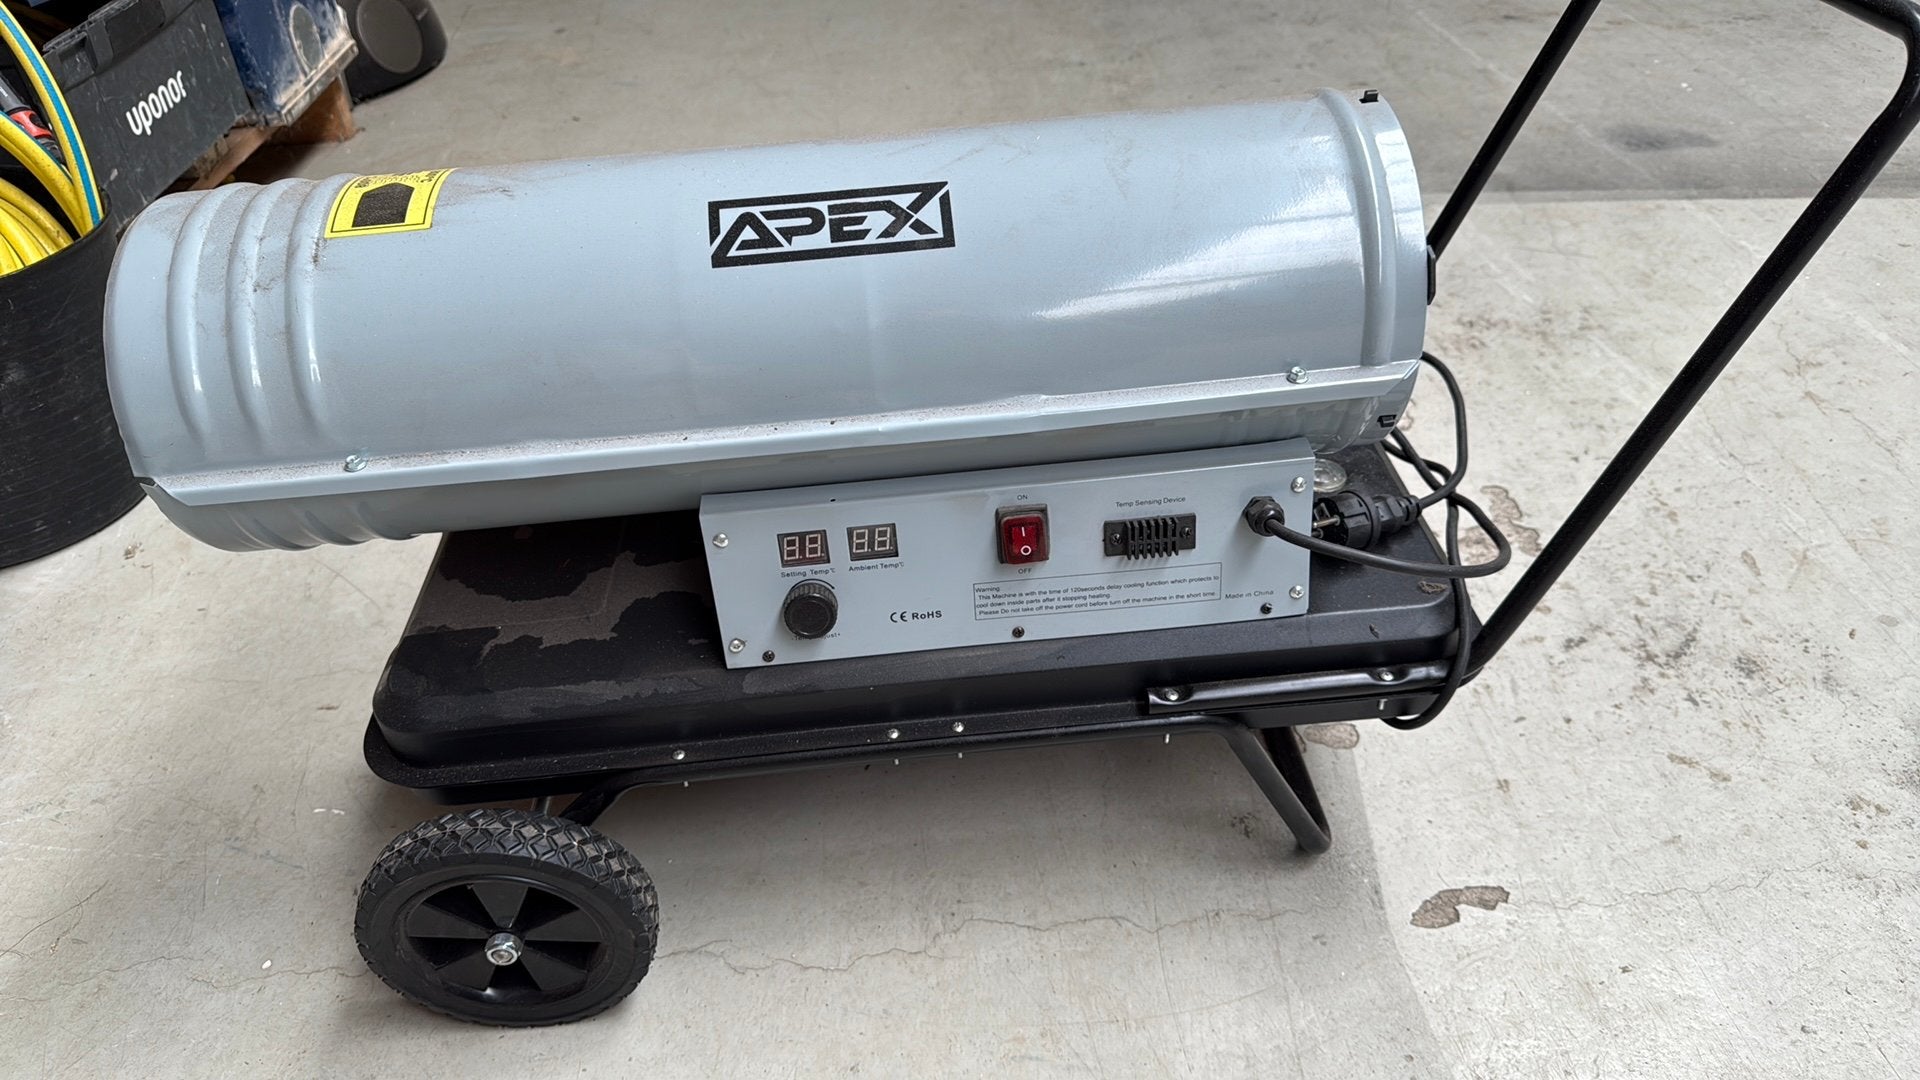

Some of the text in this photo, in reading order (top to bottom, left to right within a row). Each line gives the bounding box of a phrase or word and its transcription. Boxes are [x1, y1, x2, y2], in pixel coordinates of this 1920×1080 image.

[125, 70, 187, 136] uponor
[711, 184, 951, 267] APEX
[1135, 498, 1162, 506] Sensing
[1163, 496, 1186, 504] Device
[849, 563, 879, 572] Ambient
[780, 570, 807, 578] Setting
[992, 592, 1017, 600] Machine
[1106, 583, 1122, 591] delay
[1123, 581, 1145, 590] cooling
[1146, 579, 1170, 587] function
[1170, 577, 1187, 585] which
[1188, 576, 1212, 584] protects
[1225, 592, 1244, 600] Made
[1253, 589, 1274, 597] China
[990, 600, 1006, 608] down
[1025, 598, 1041, 606] parts
[1062, 594, 1088, 602] stopping
[1035, 604, 1044, 612] off
[1055, 603, 1074, 611] power
[1089, 600, 1108, 608] before
[1142, 595, 1168, 603] machine
[912, 610, 943, 621] RoHS
